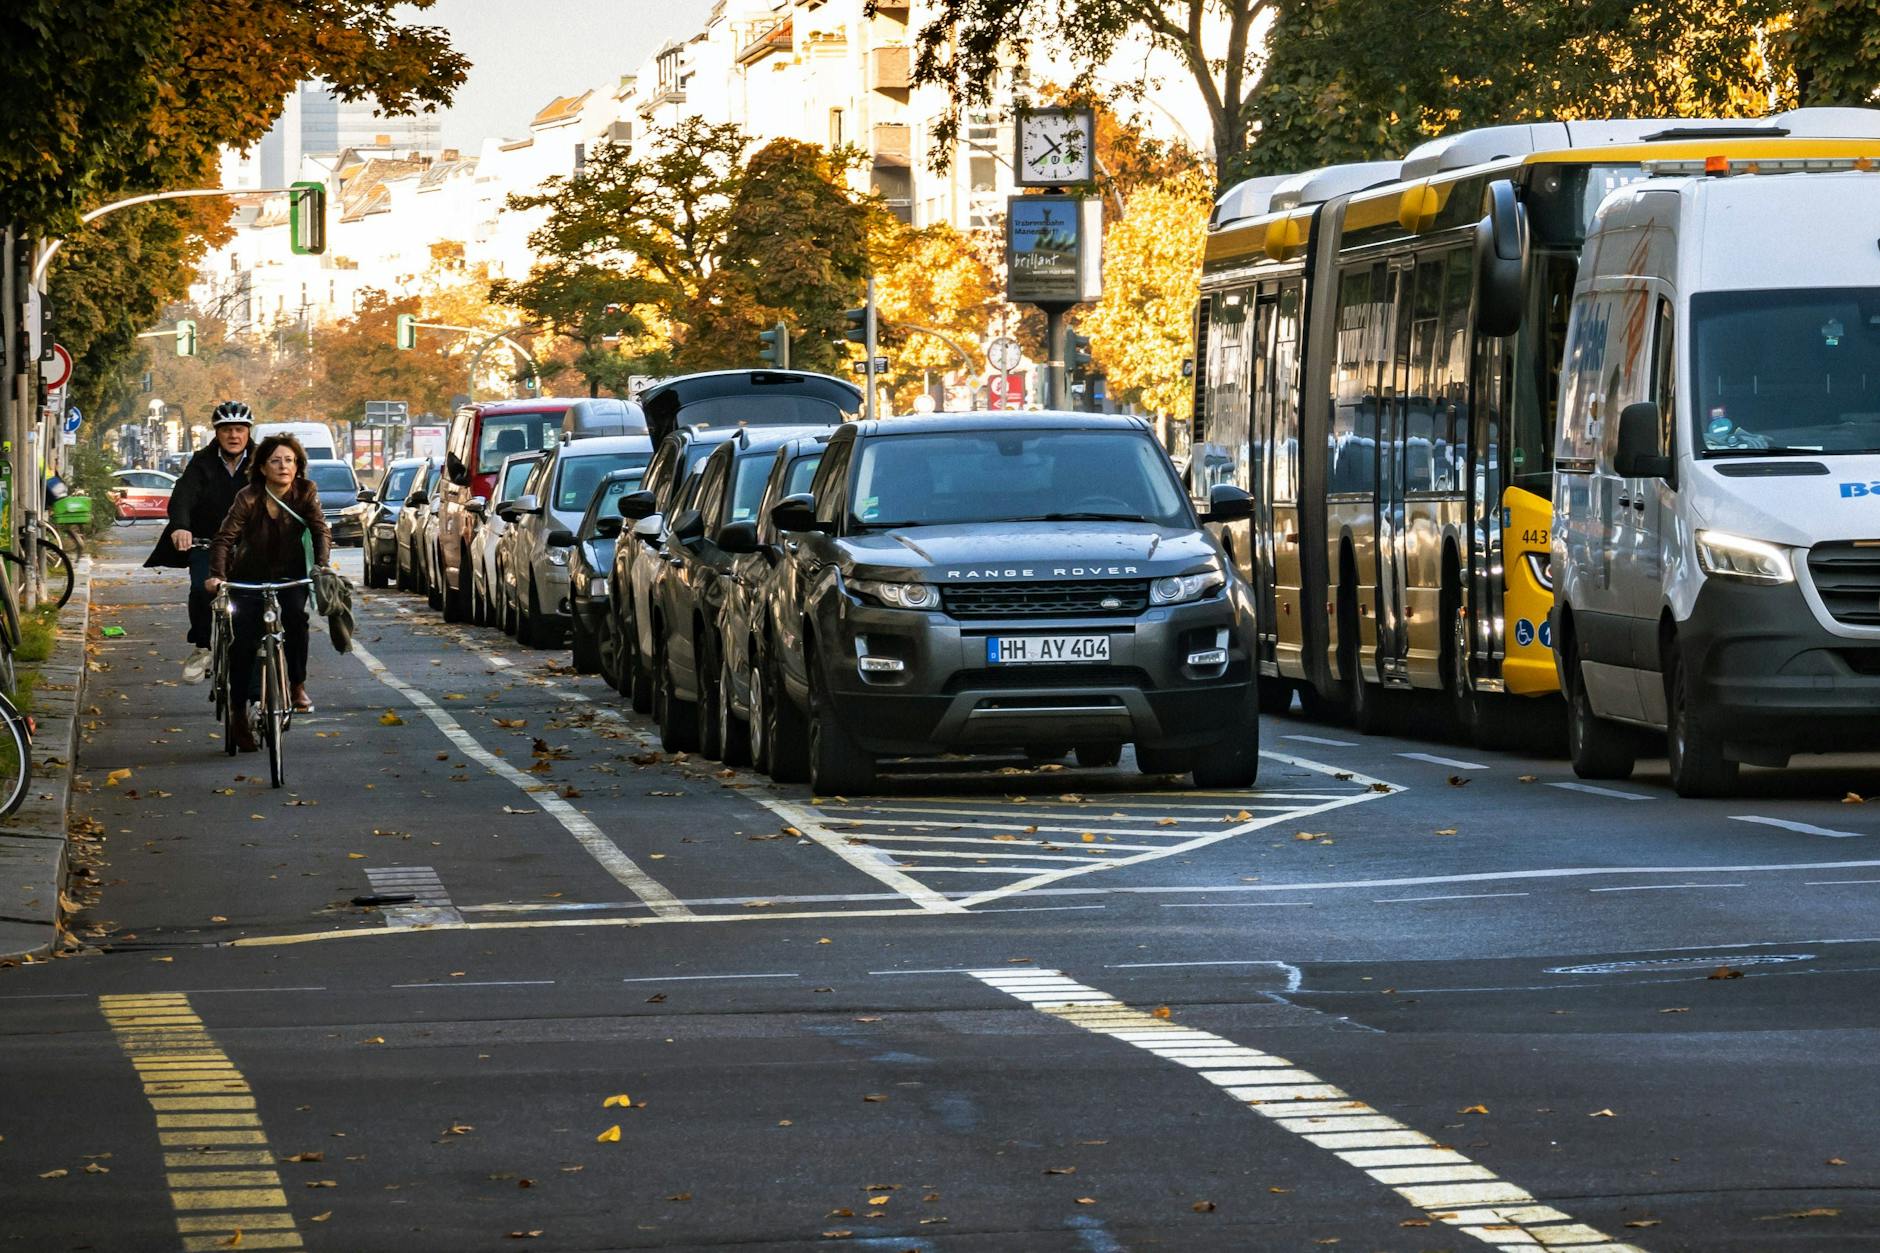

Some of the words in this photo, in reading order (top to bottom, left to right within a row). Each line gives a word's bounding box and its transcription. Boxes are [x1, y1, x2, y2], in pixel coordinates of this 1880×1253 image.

[1014, 252, 1060, 270] brillant
[1522, 529, 1548, 545] 443
[947, 569, 1034, 578] RANGE
[1053, 566, 1138, 576] ROVER
[1000, 639, 1026, 660] HH
[1040, 639, 1067, 659] AY
[1070, 638, 1108, 658] 404
